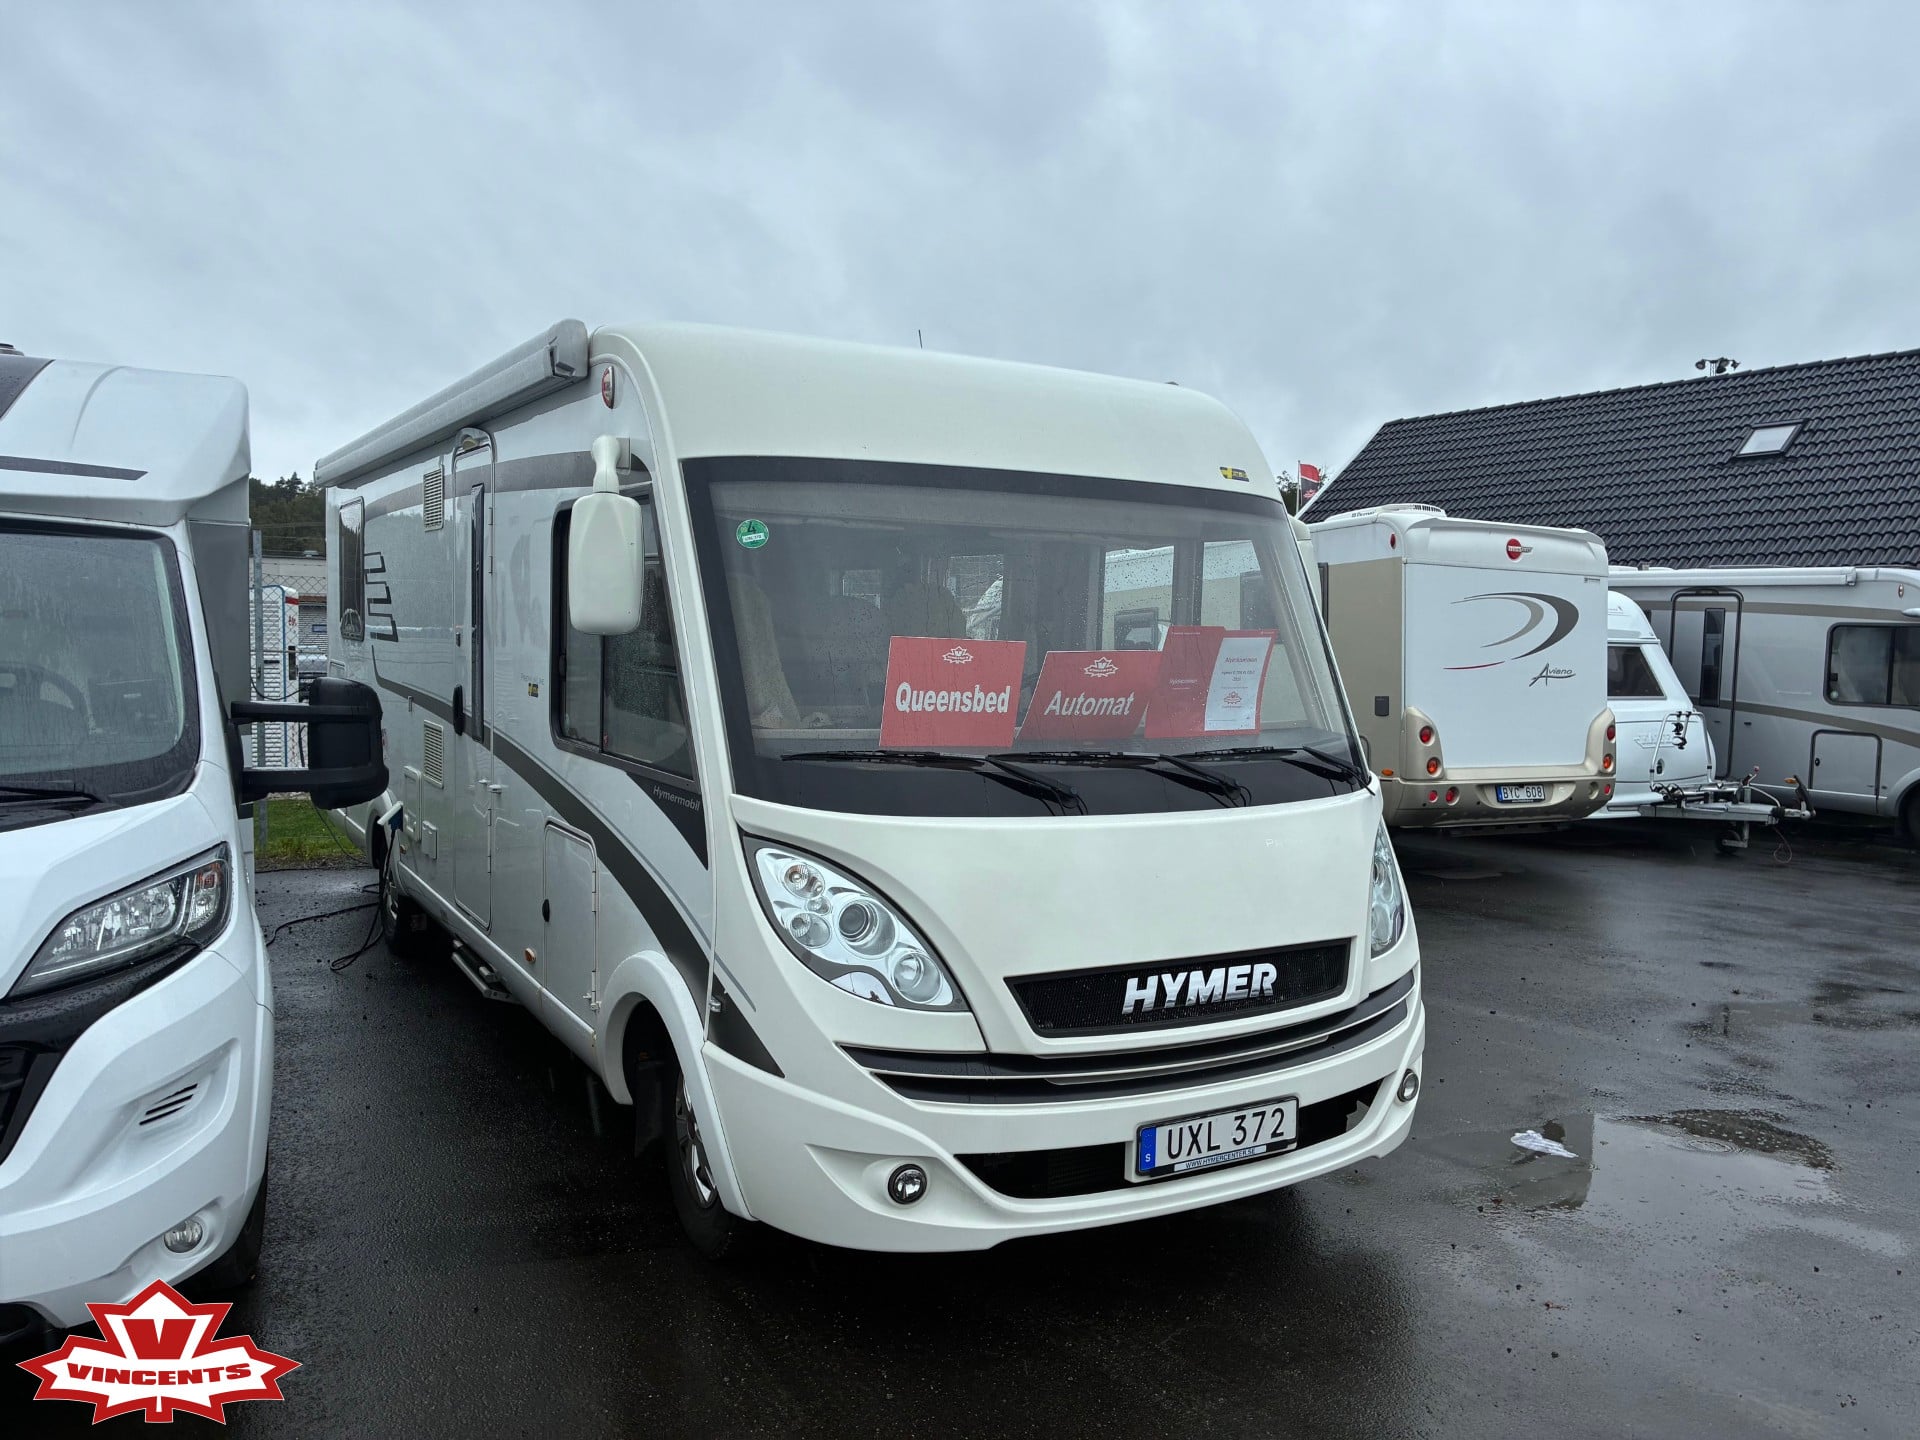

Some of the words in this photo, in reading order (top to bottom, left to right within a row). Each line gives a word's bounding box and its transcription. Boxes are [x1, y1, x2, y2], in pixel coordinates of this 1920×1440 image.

[1529, 662, 1576, 687] Aviano
[895, 682, 1011, 713] Queensbed
[1043, 690, 1135, 716] Automat
[653, 785, 701, 811] Hymermobil
[1503, 787, 1520, 799] BYC
[1525, 786, 1543, 798] 608
[1121, 962, 1278, 1015] HYMER
[1167, 1121, 1221, 1160] UXL
[1232, 1107, 1285, 1146] 372
[1145, 1153, 1151, 1162] S
